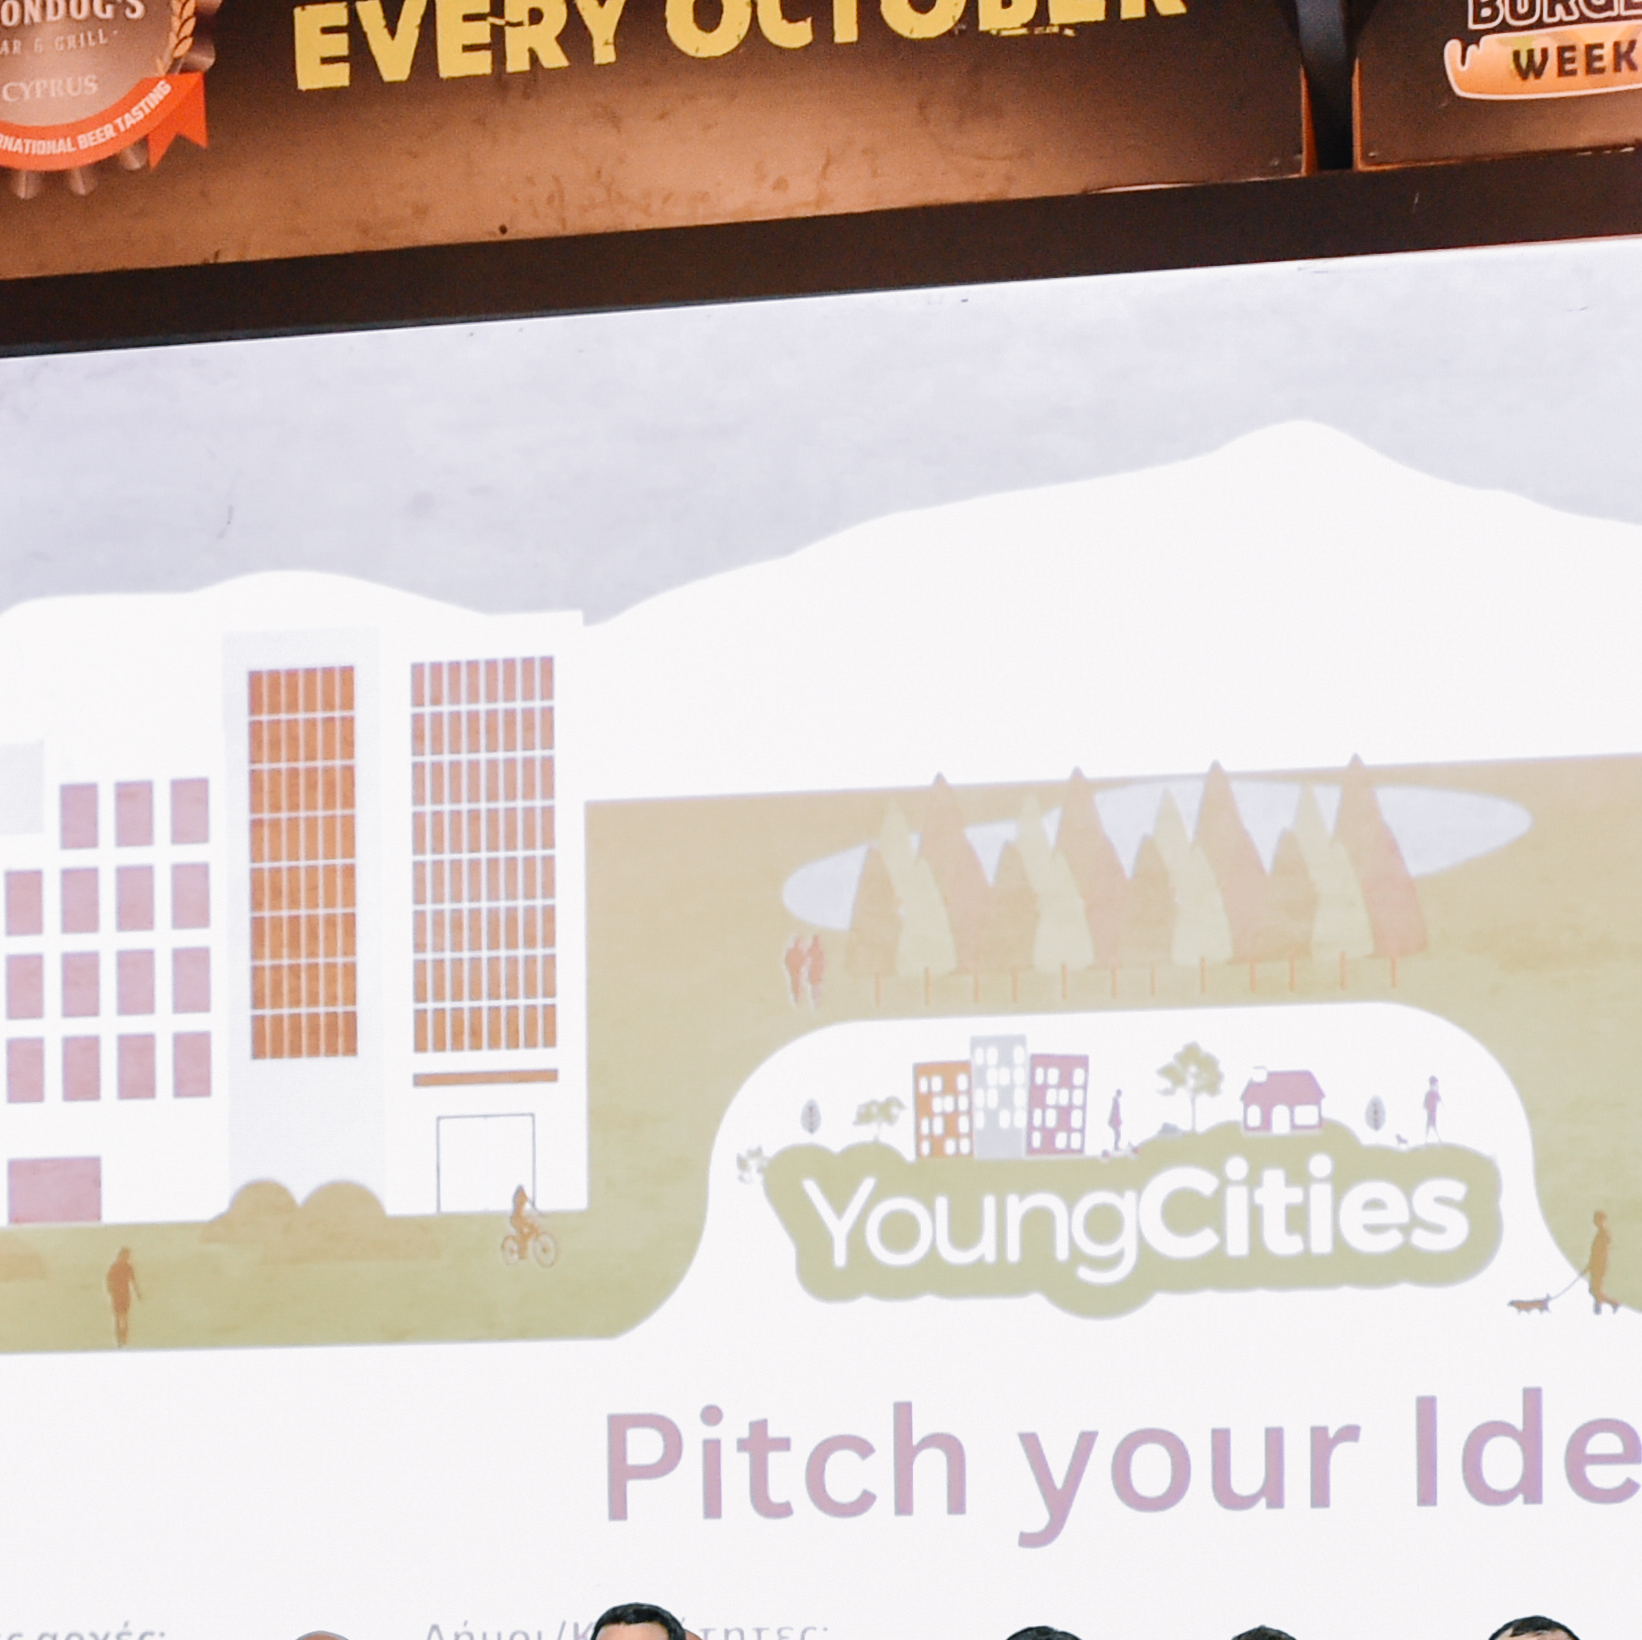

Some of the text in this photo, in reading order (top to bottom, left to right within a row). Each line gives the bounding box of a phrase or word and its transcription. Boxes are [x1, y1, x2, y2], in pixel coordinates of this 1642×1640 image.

[54, 29, 108, 51] GRILL
[293, 0, 623, 91] EVERY
[1512, 39, 1638, 81] WEEK
[2, 75, 98, 102] CYPRUS
[77, 124, 116, 150] BEER
[115, 79, 172, 134] TASTING
[802, 1153, 1470, 1286] YoungCities
[606, 1399, 968, 1522] Pitch
[1016, 1423, 1362, 1549] your
